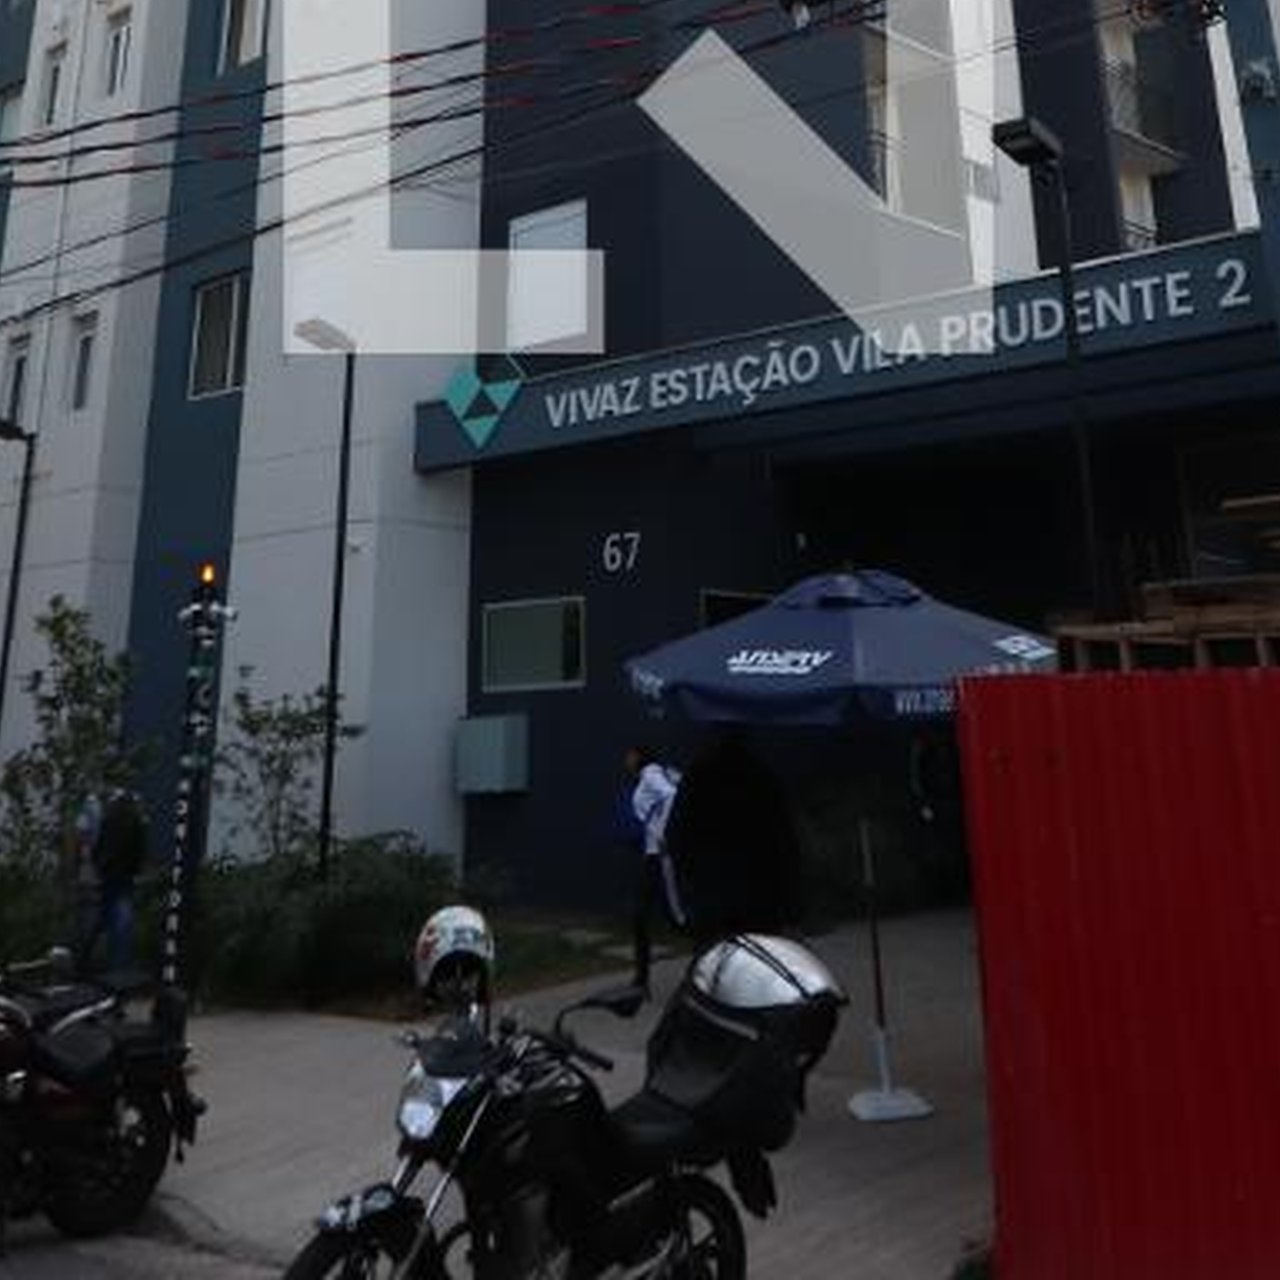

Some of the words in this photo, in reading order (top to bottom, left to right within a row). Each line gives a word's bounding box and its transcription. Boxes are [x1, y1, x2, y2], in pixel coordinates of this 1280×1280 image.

[545, 375, 641, 428] VIVAZ
[650, 339, 819, 406] ESTAÇÃO
[831, 321, 925, 375] VILA
[940, 271, 1195, 357] PRUDENTE
[1216, 258, 1252, 308] 2
[602, 531, 641, 572] 67
